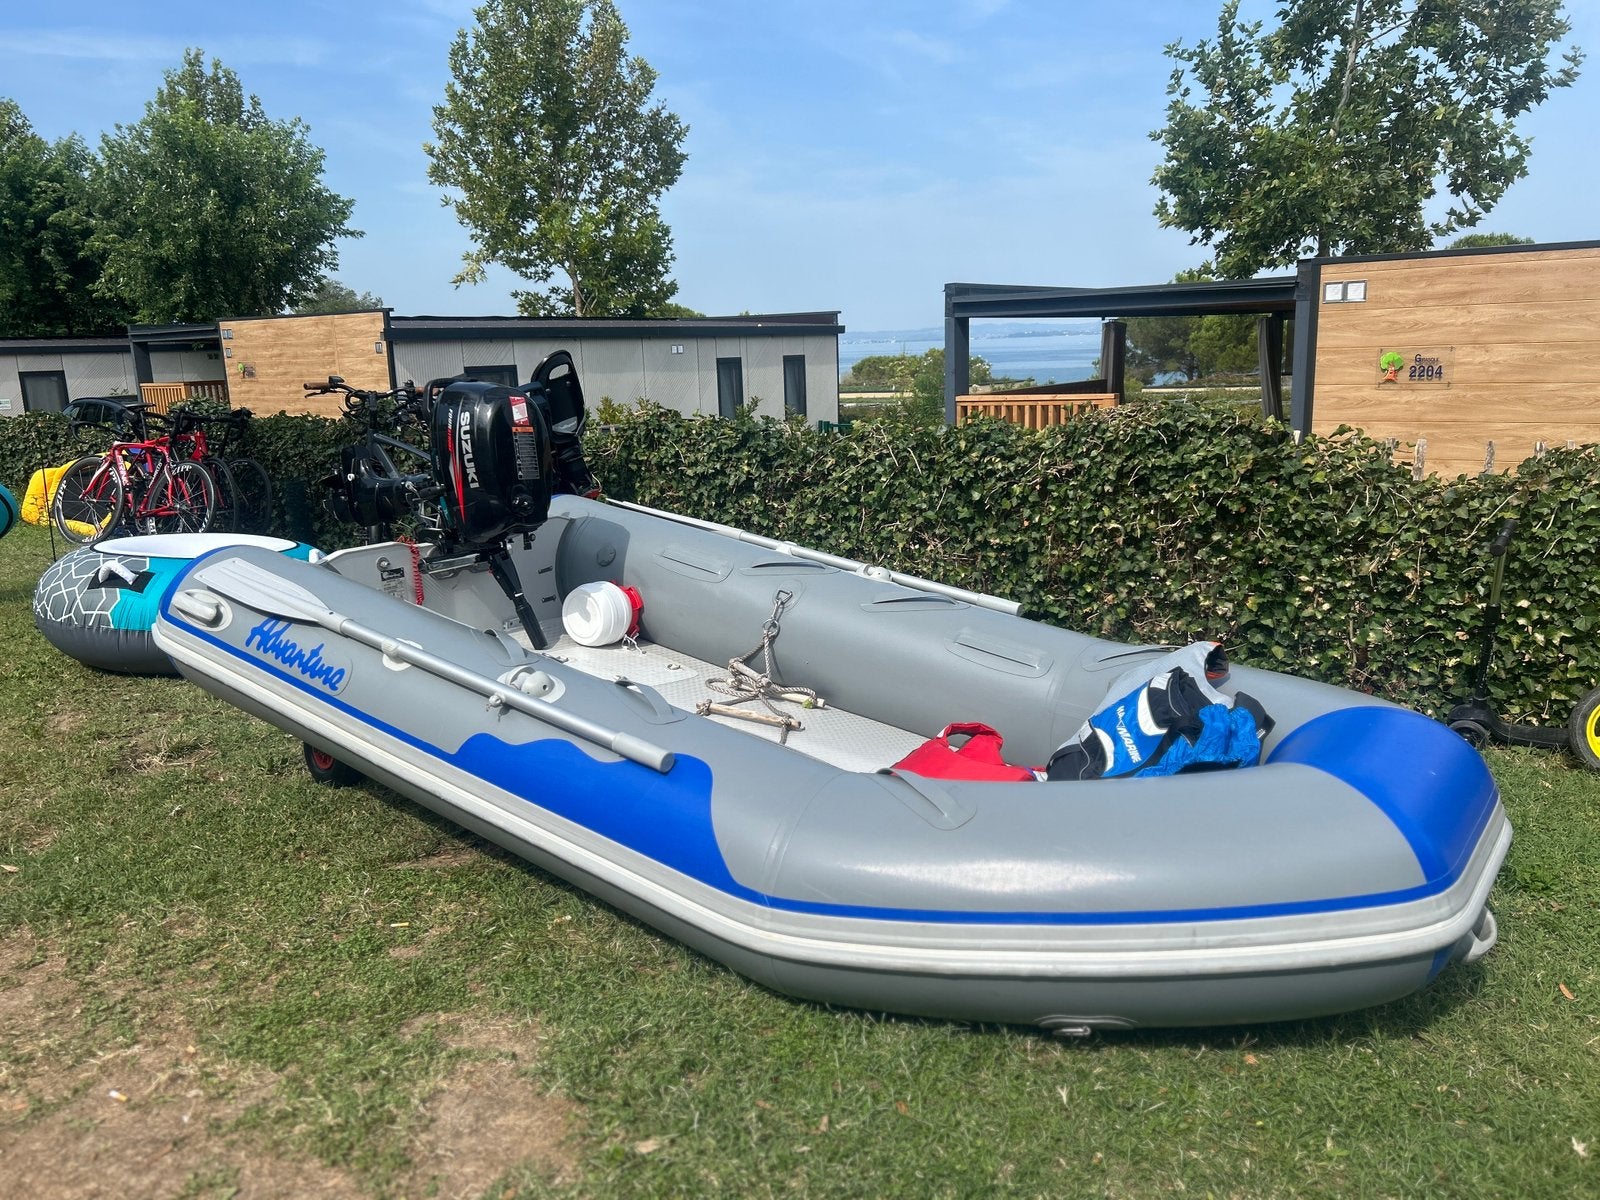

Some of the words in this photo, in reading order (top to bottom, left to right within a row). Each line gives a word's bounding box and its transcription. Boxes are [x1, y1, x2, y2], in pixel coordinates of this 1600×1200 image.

[1409, 365, 1442, 378] 2204
[172, 465, 192, 476] ZIPP
[460, 411, 480, 488] SUZUKI
[245, 616, 345, 691] Adventure
